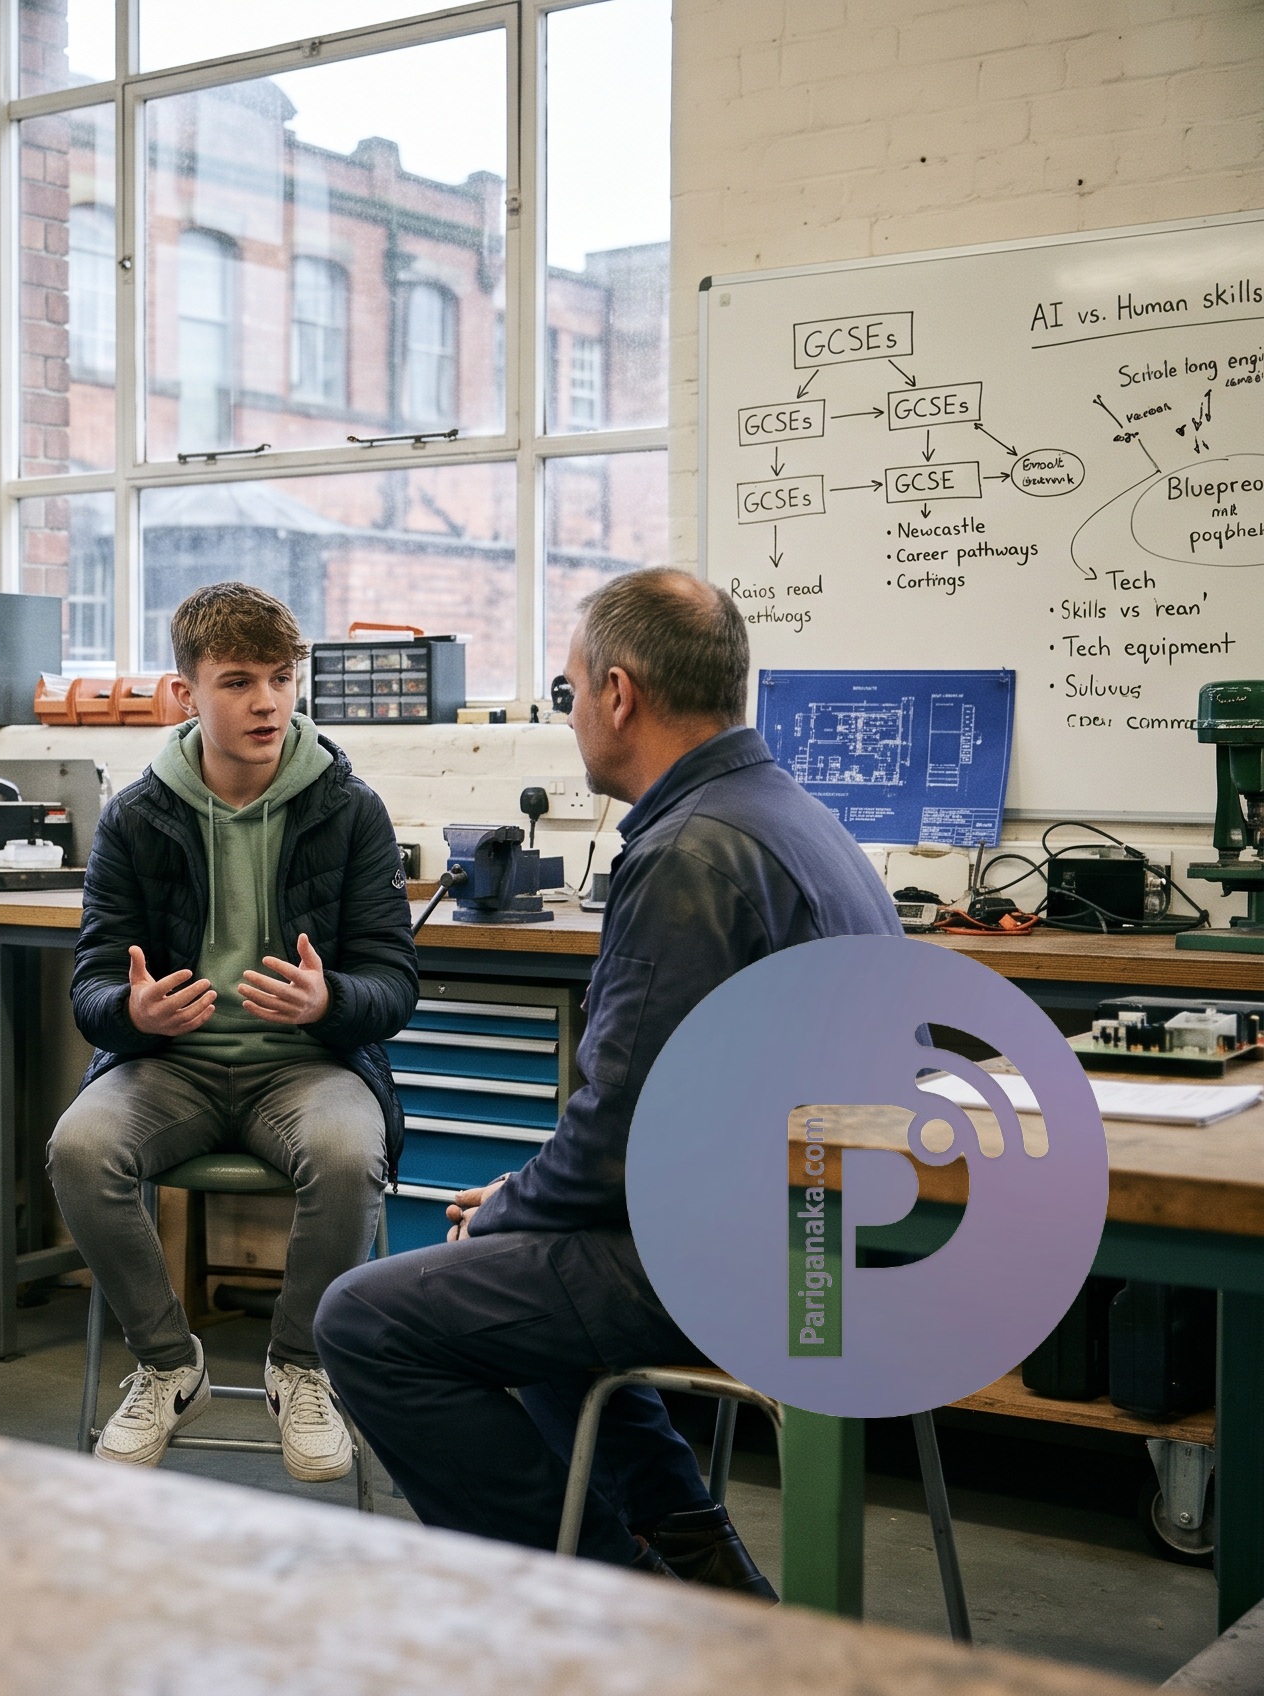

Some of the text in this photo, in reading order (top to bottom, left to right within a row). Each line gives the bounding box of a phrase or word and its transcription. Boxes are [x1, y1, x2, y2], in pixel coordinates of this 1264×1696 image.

[1030, 278, 1263, 331] AI vs. Human skills
[803, 322, 897, 358] GCSEs
[1185, 356, 1218, 381] long
[893, 394, 969, 420] GCSEs
[744, 410, 813, 436] GCSEs
[894, 470, 955, 494] GCSE
[743, 487, 812, 513] GCSEs
[897, 516, 986, 538] Newcastle
[896, 541, 1039, 567] Career pathways
[786, 574, 824, 596] read
[1105, 569, 1156, 590] Tech
[1061, 599, 1107, 619] Skills
[1120, 605, 1140, 618] vs
[1062, 631, 1236, 666] Tech equipment
